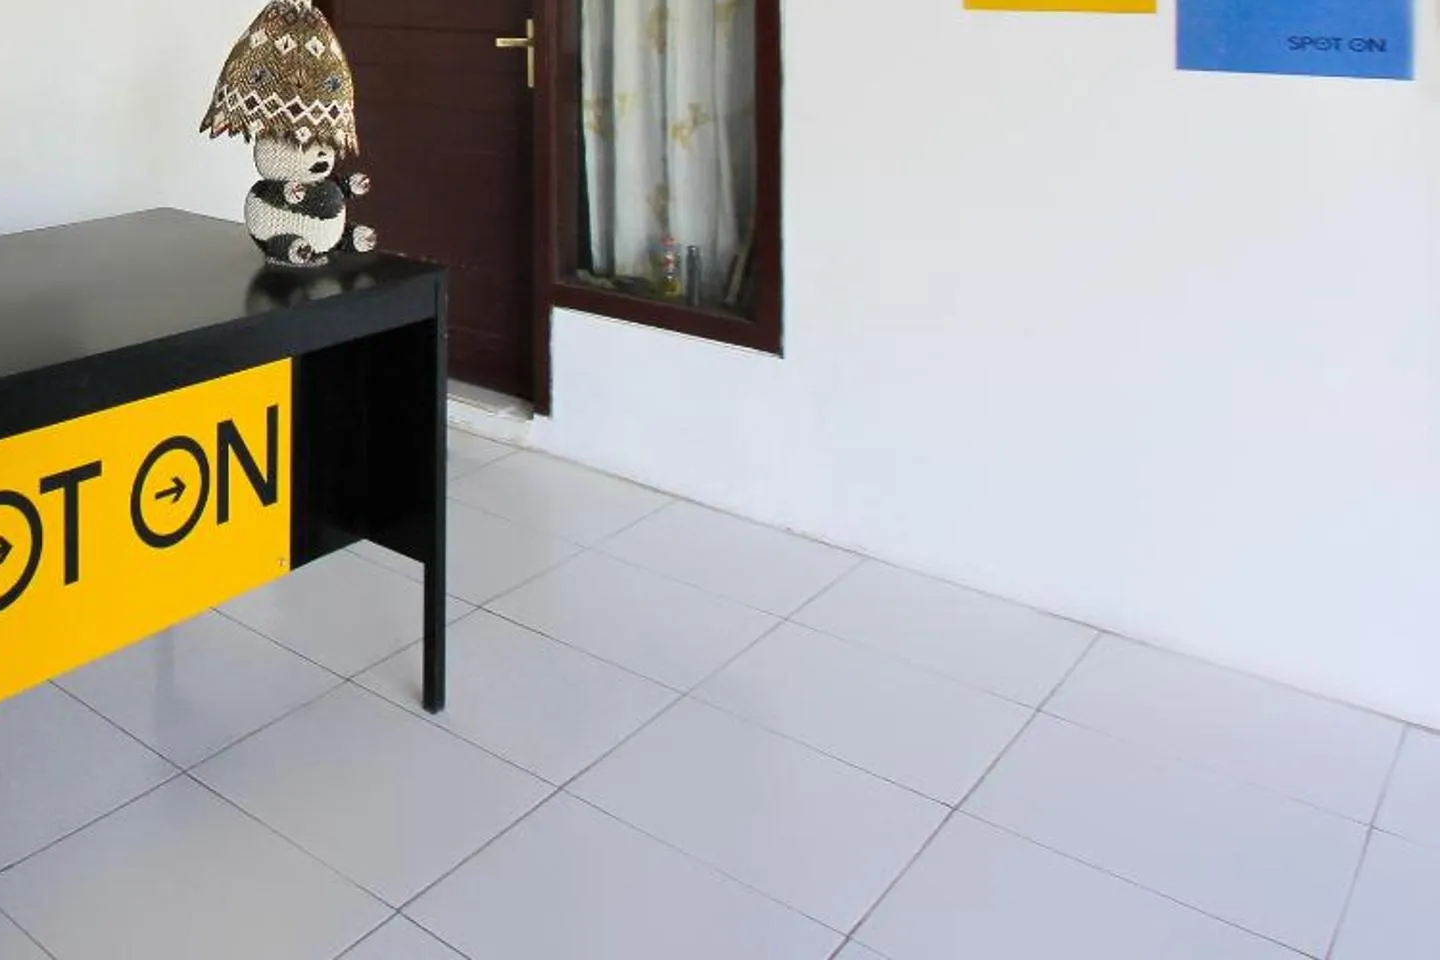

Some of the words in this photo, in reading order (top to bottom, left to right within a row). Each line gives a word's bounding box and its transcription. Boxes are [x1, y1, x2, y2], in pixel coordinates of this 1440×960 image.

[1287, 35, 1342, 52] SPOT
[1348, 37, 1388, 53] ON
[130, 404, 280, 549] ON
